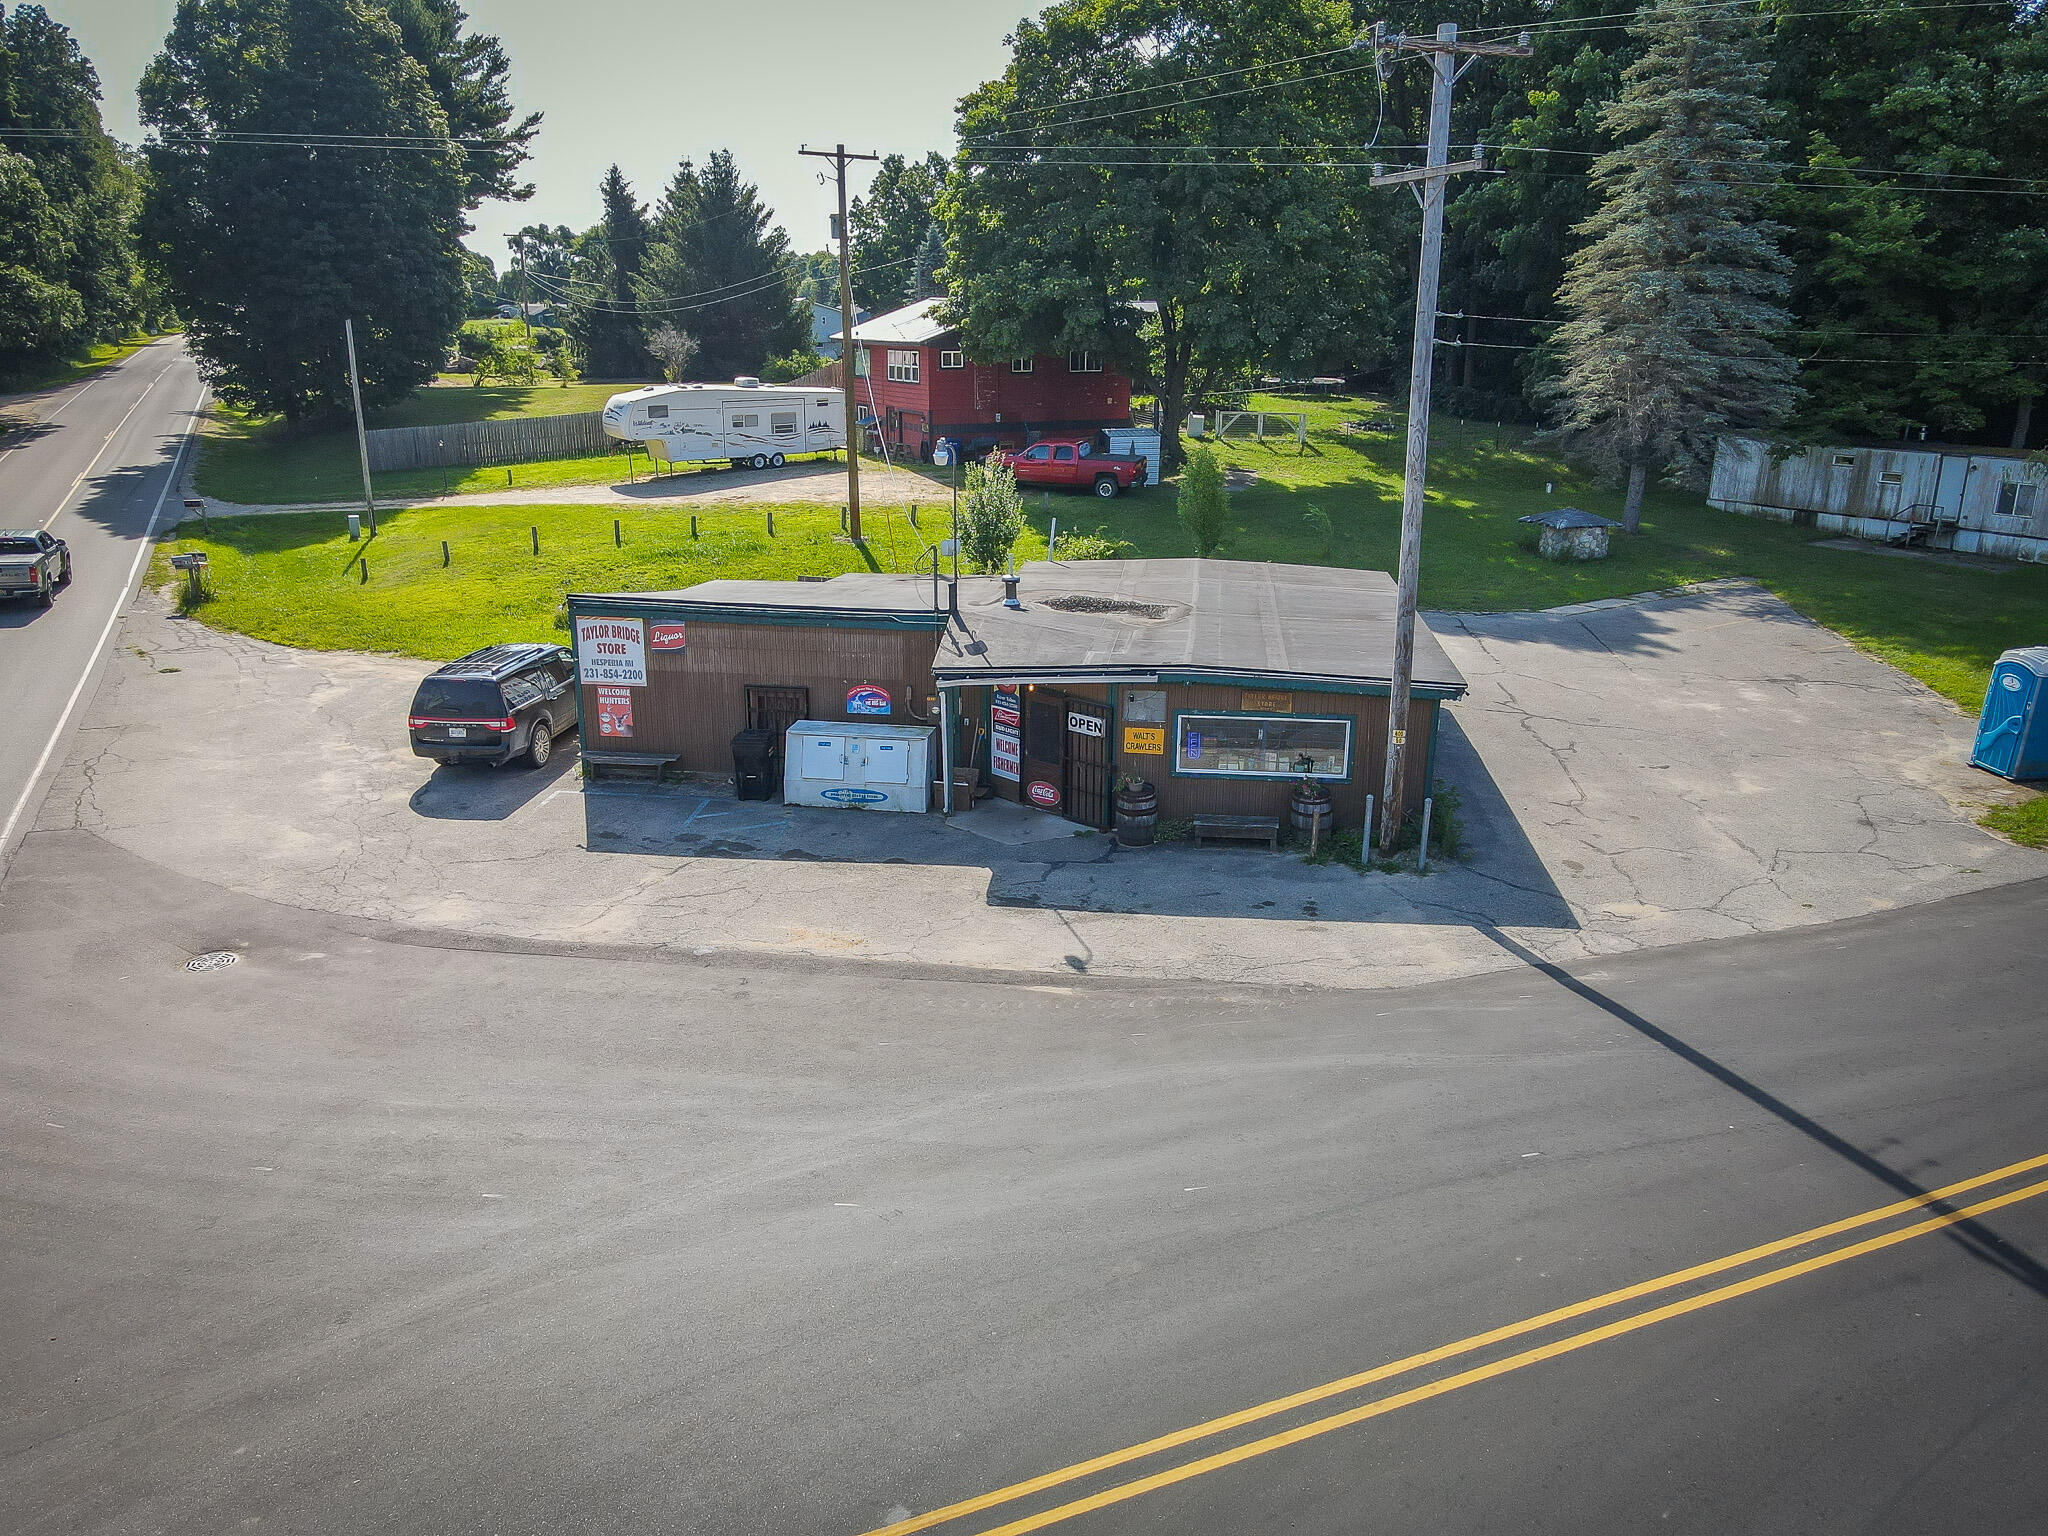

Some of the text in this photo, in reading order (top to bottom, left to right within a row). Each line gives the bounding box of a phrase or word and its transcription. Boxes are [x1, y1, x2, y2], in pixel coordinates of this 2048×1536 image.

[581, 624, 641, 645] TAYLOR BRIDGE
[652, 631, 684, 644] Liquor
[596, 643, 627, 654] STORE
[584, 668, 643, 680] 231-854-2200
[597, 688, 631, 696] WELCOME
[600, 697, 630, 705] HUNTERS
[1069, 716, 1103, 734] OPEN
[995, 737, 1019, 757] WELCOME
[1126, 742, 1162, 752] CRAWLERS
